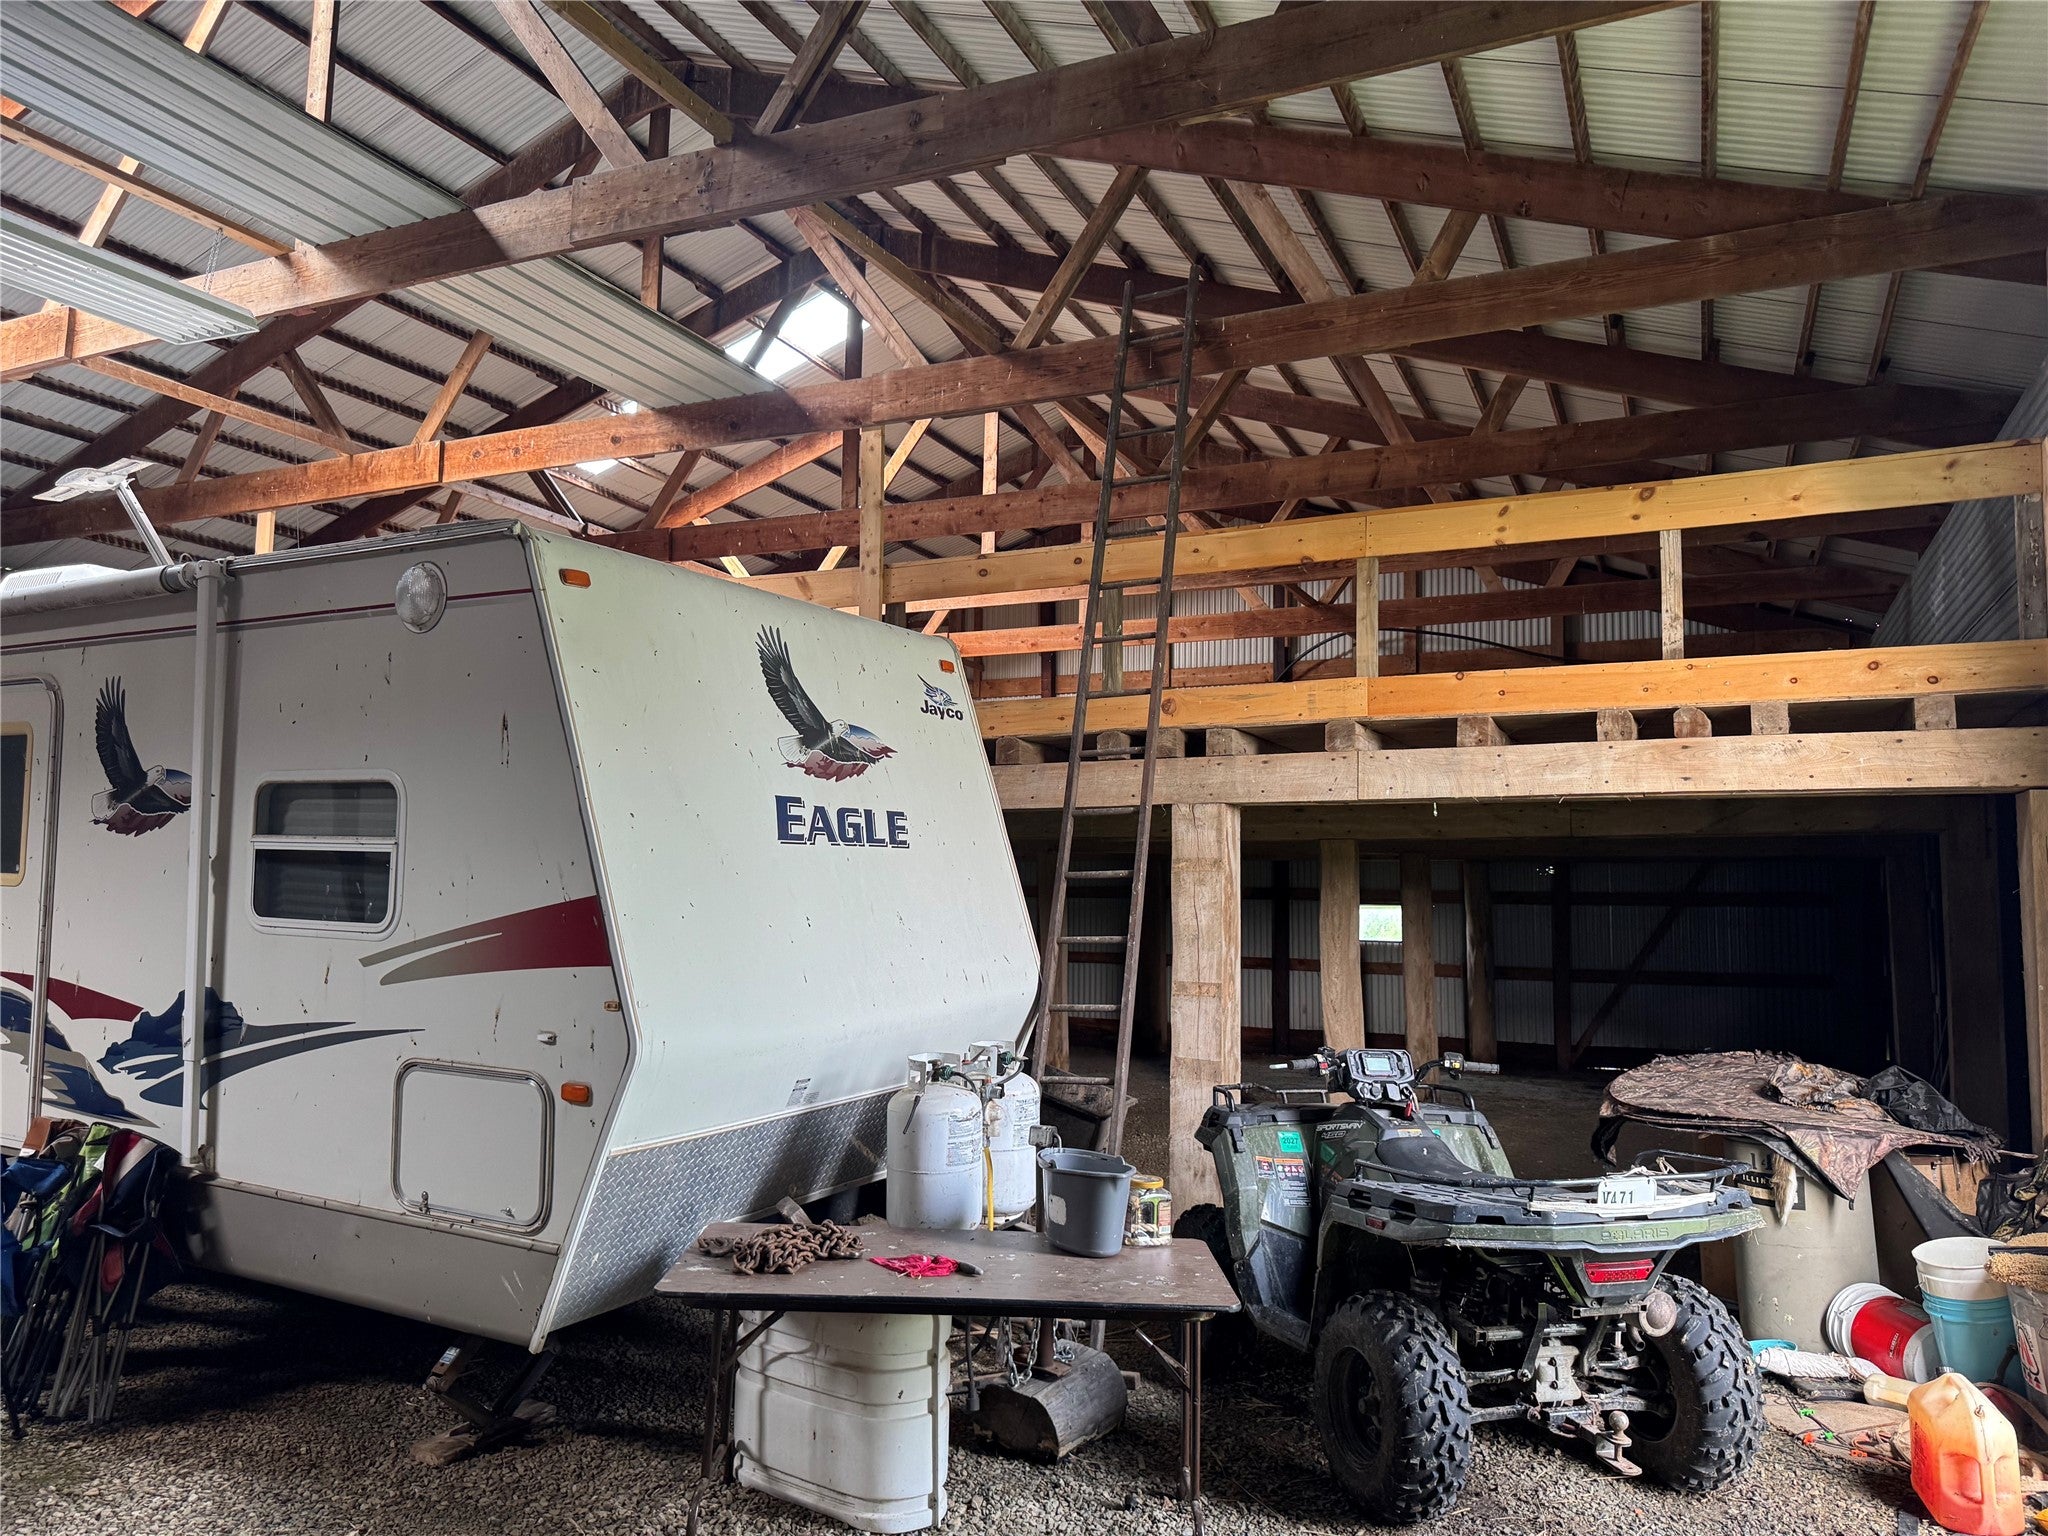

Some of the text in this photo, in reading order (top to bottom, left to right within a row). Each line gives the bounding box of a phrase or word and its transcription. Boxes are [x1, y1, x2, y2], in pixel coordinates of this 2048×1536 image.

[920, 700, 964, 720] Jayco
[775, 795, 910, 848] EAGLE
[1316, 1122, 1364, 1132] SPORTSMAN
[1282, 1137, 1299, 1145] 2027
[1601, 1227, 1669, 1241] POLARIS
